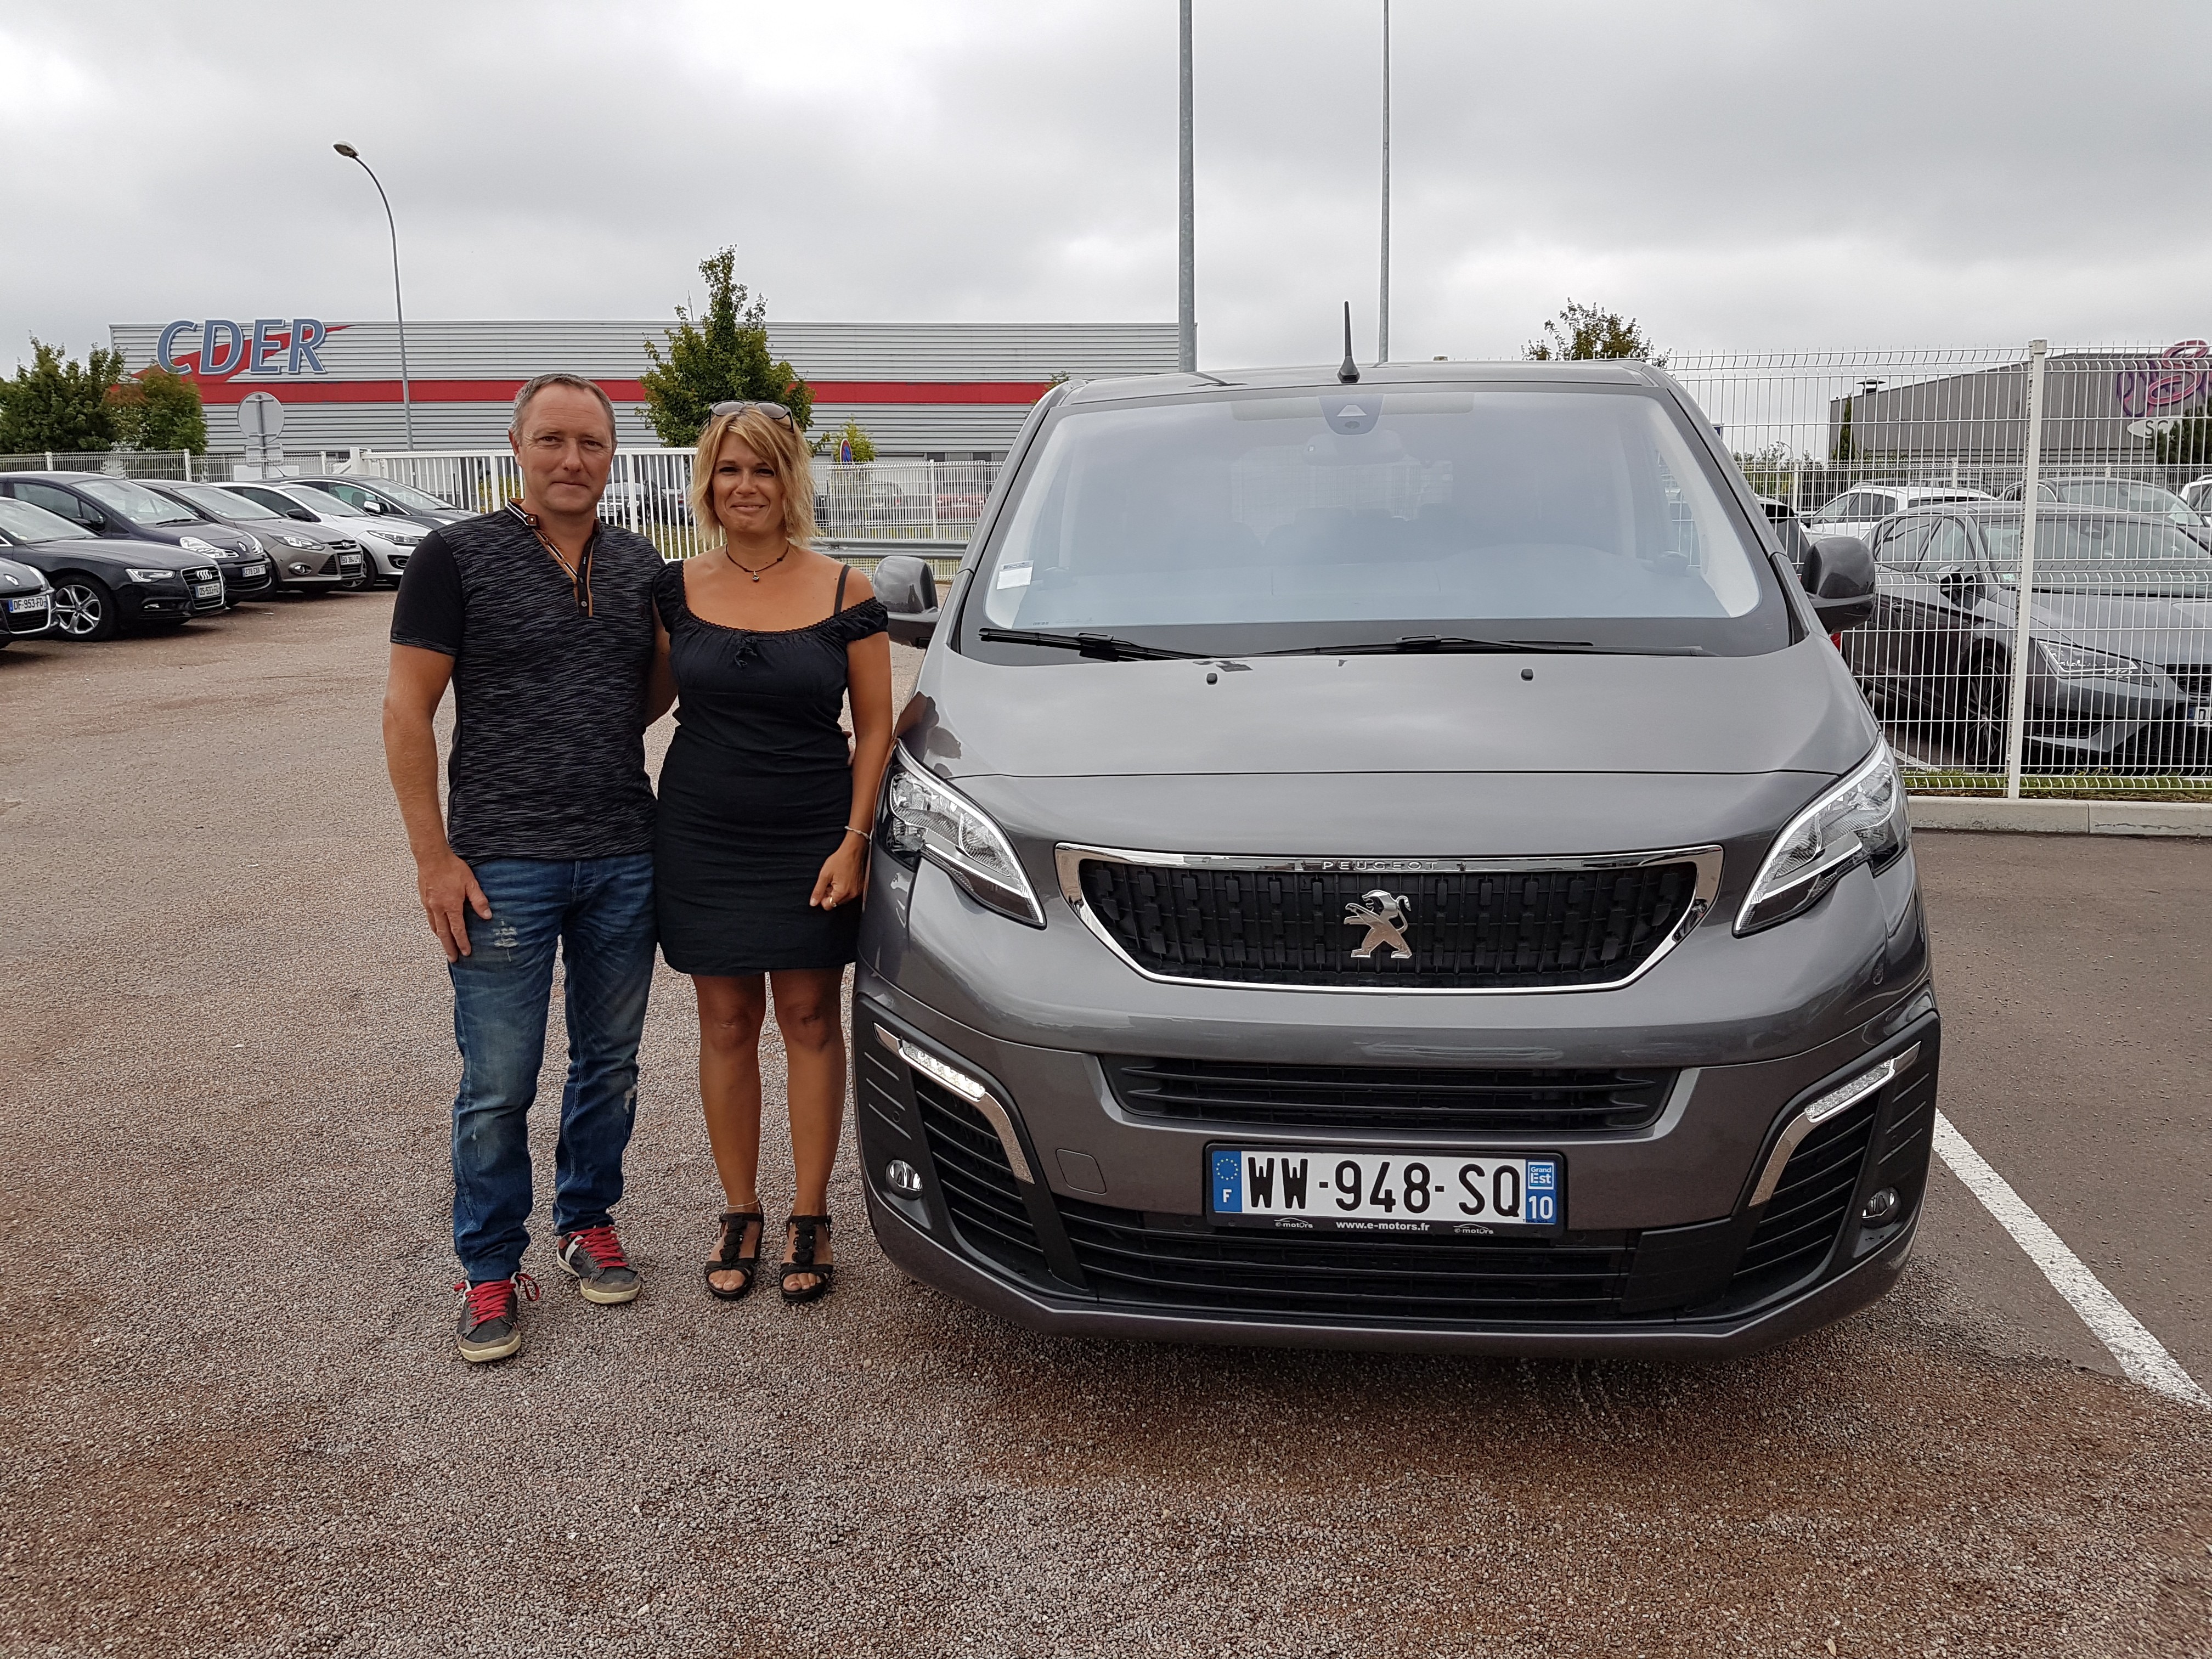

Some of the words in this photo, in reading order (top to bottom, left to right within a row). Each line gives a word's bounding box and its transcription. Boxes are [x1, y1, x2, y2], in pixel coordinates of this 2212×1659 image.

[156, 317, 328, 375] CDER
[13, 597, 43, 610] DF-953-FD
[1322, 861, 1438, 870] PEUGEOT
[1530, 1172, 1551, 1184] Est
[1223, 1189, 1232, 1203] F
[1528, 1195, 1553, 1220] 10
[1335, 1221, 1430, 1231] www.e-motors.fr
